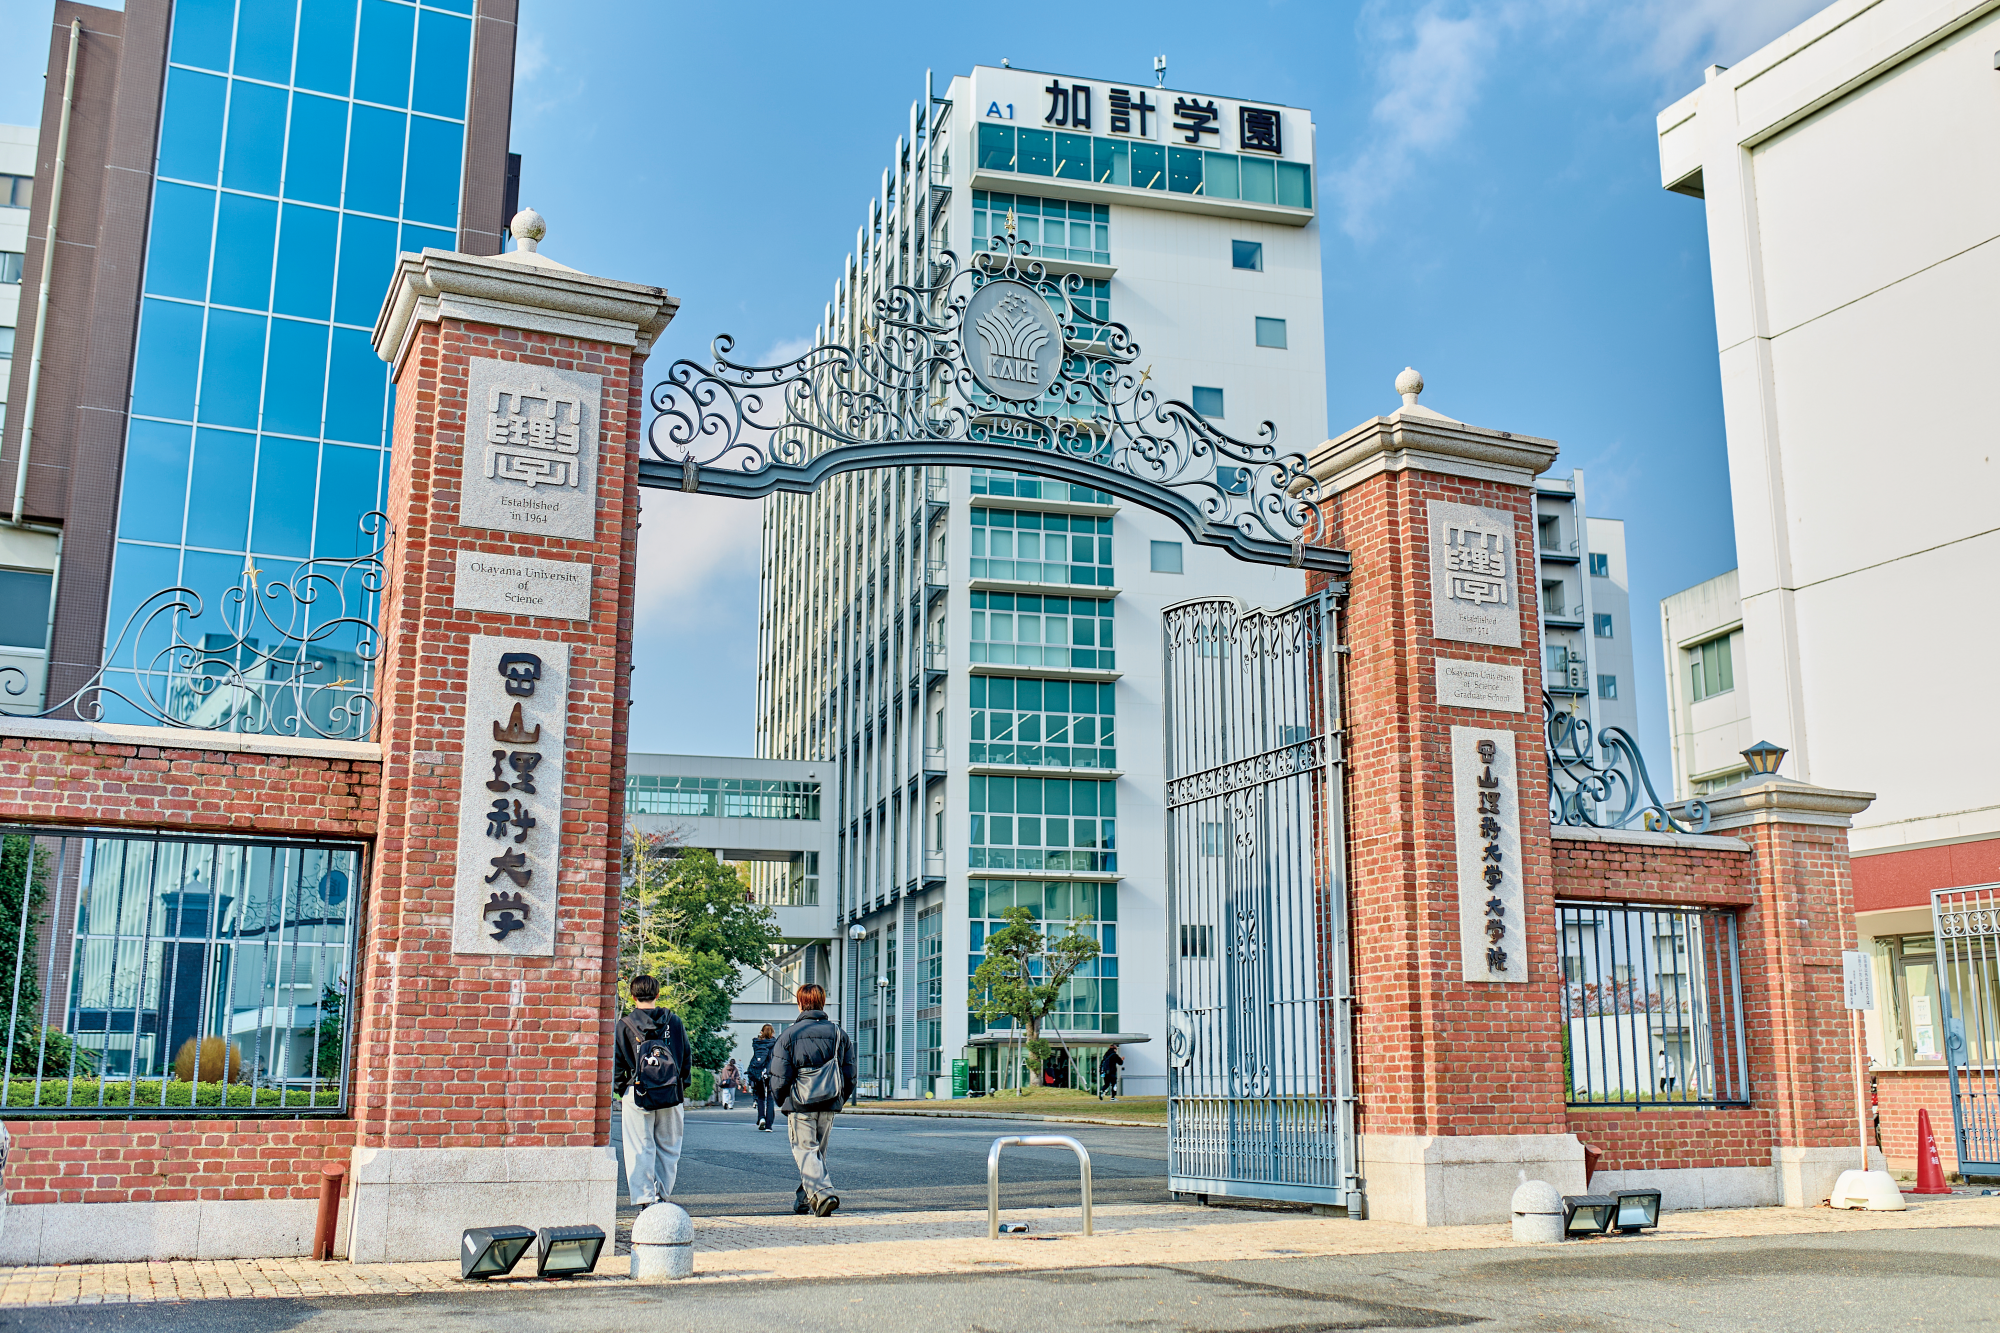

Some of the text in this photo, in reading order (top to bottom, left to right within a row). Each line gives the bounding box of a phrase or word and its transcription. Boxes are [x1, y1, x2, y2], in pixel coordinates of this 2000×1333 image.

[986, 101, 1014, 119] A1
[1045, 79, 1283, 154] 加計学園
[987, 355, 1039, 384] KAKE
[989, 417, 1034, 440] 1961
[501, 496, 560, 511] Established
[511, 511, 548, 524] in 1964
[471, 562, 579, 582] Okayama University
[517, 581, 529, 591] of
[505, 592, 543, 604] Science
[1459, 613, 1497, 625] Established
[1445, 667, 1516, 682] Okayama University
[1474, 681, 1500, 691] Science
[1454, 690, 1486, 700] Graduate
[483, 652, 542, 942] 岡山理科大学
[1476, 739, 1508, 974] 岡山理科大学大学院
